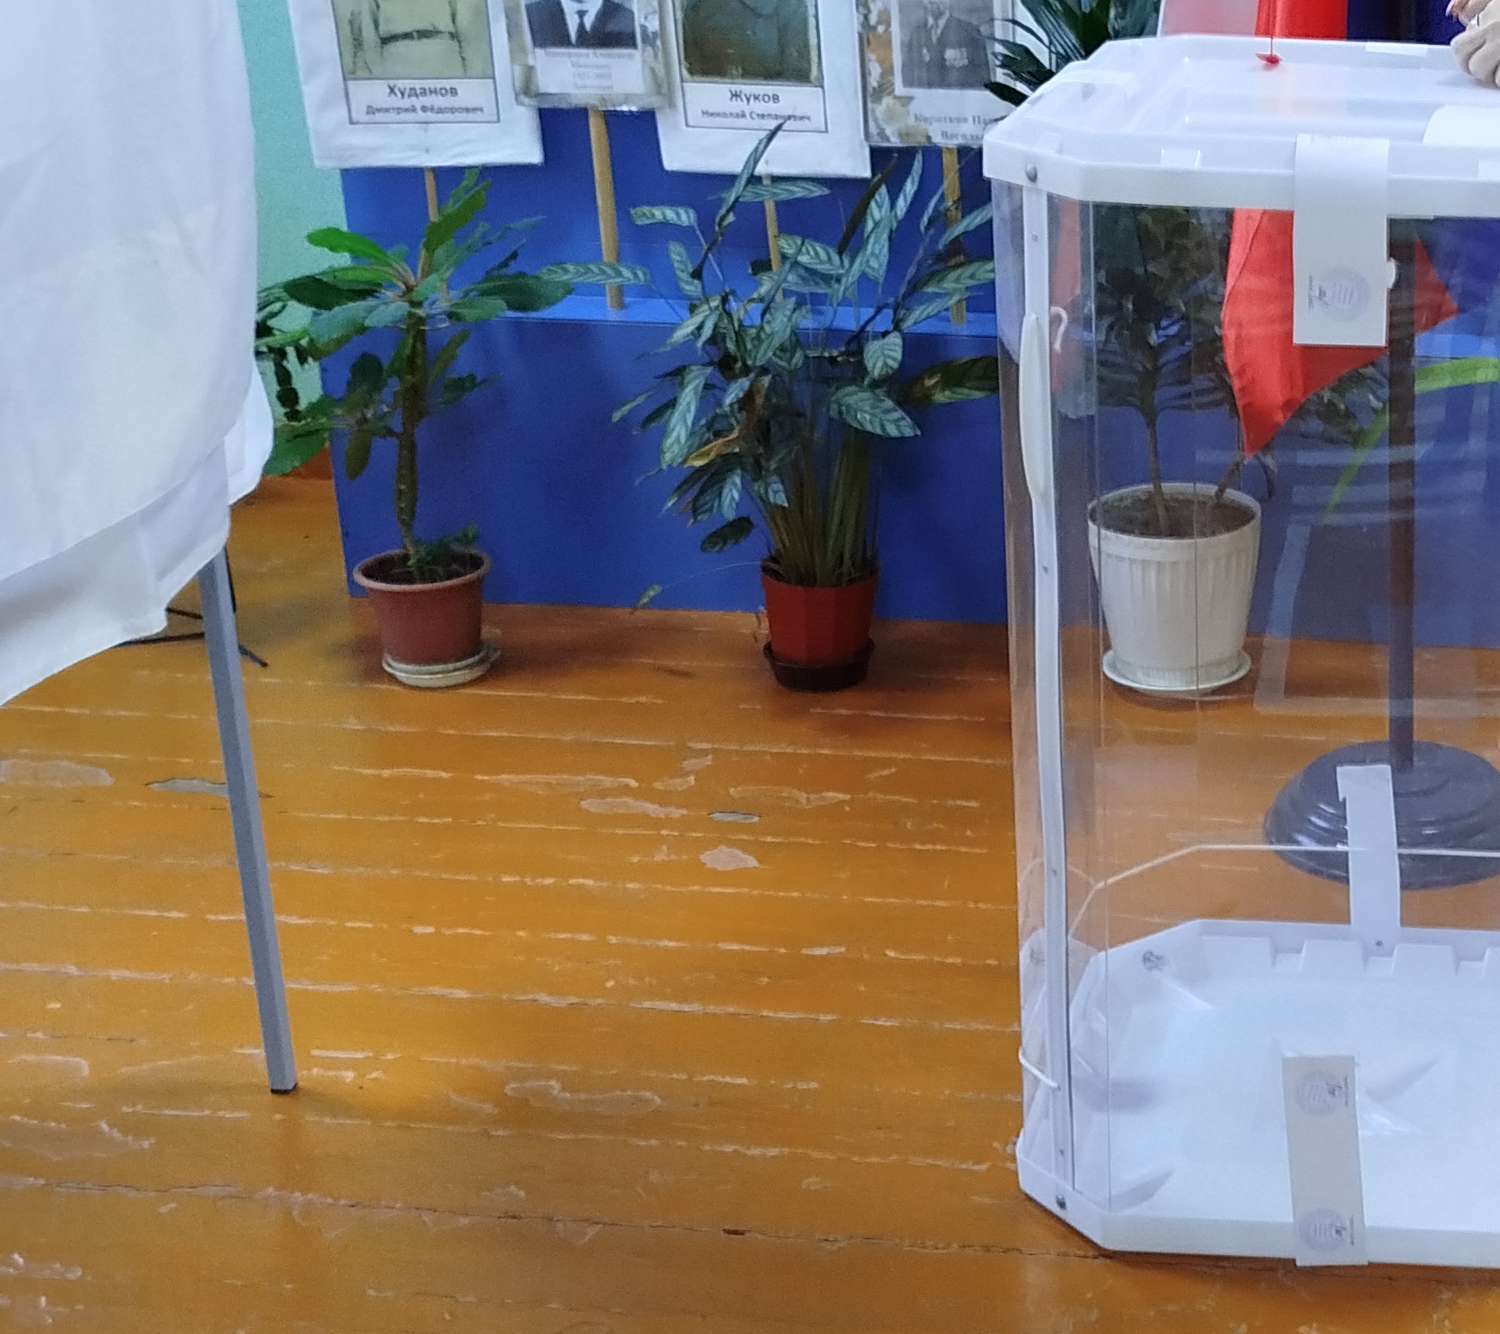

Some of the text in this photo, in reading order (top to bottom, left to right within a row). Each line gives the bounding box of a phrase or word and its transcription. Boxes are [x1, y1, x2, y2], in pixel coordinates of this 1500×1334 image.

[387, 84, 459, 99] Худанов
[729, 89, 781, 105] Жуков
[366, 105, 418, 115] Дмитрий
[701, 109, 747, 120] Николай
